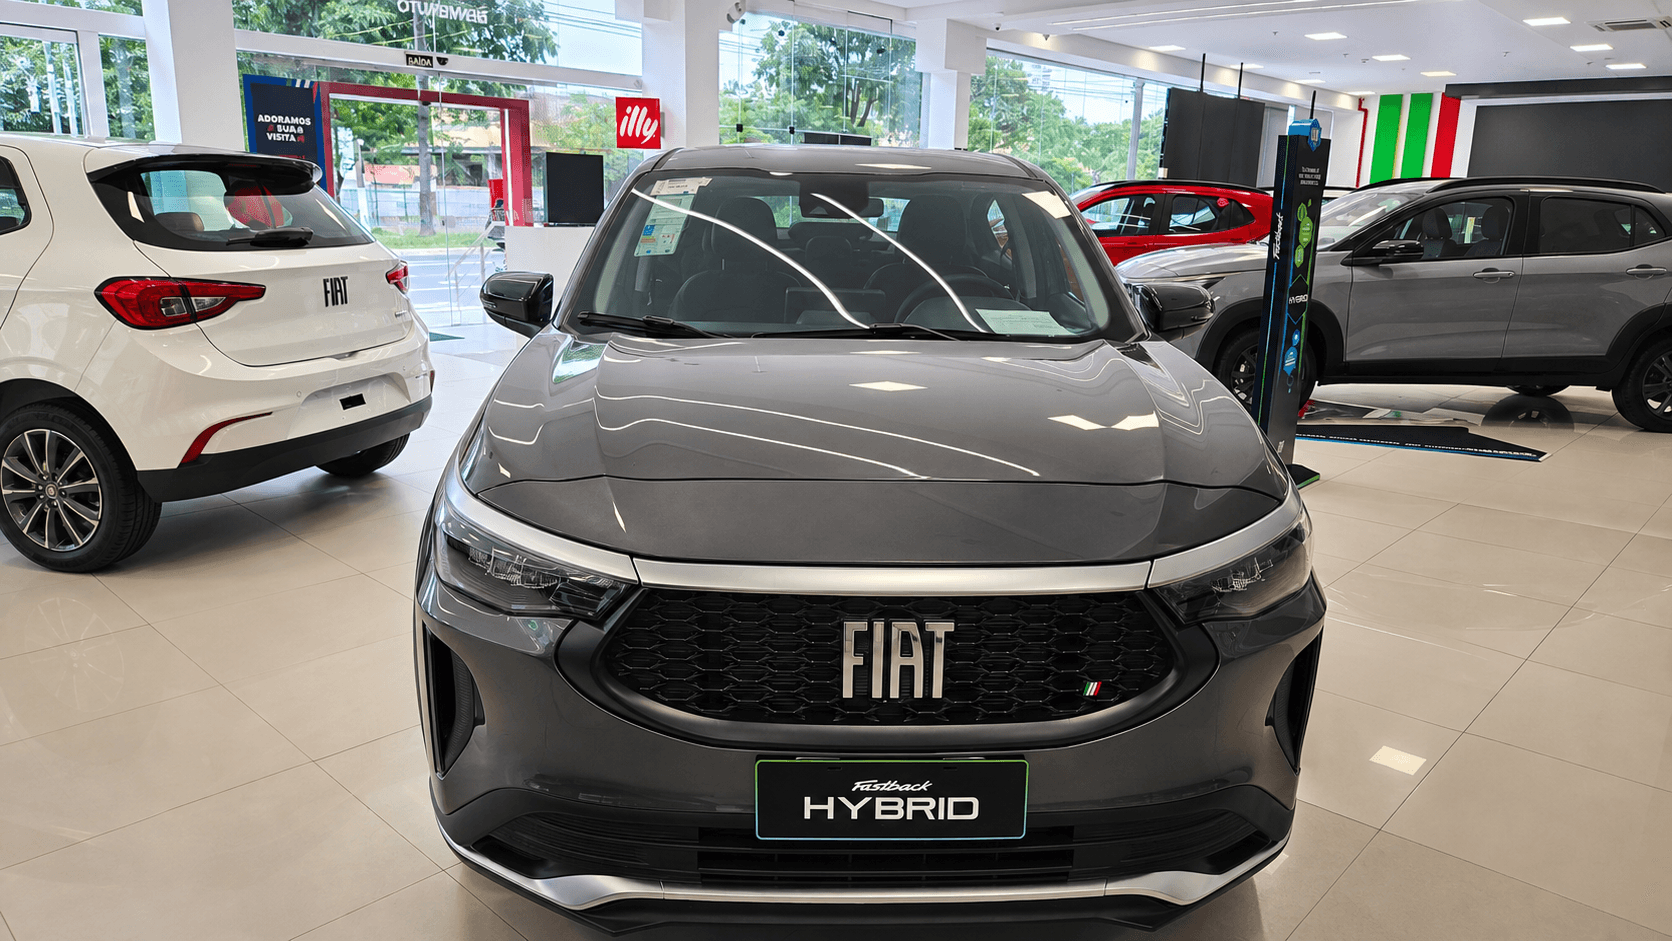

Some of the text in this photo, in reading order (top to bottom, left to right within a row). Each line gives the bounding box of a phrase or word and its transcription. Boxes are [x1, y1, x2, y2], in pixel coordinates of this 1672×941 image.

[257, 114, 312, 126] ADORAMOS
[619, 105, 659, 145] illy
[266, 132, 297, 142] VISITA
[322, 276, 349, 308] FIAT
[842, 620, 955, 699] FIAT
[851, 779, 933, 792] Fastback
[803, 796, 980, 820] HYBRID
